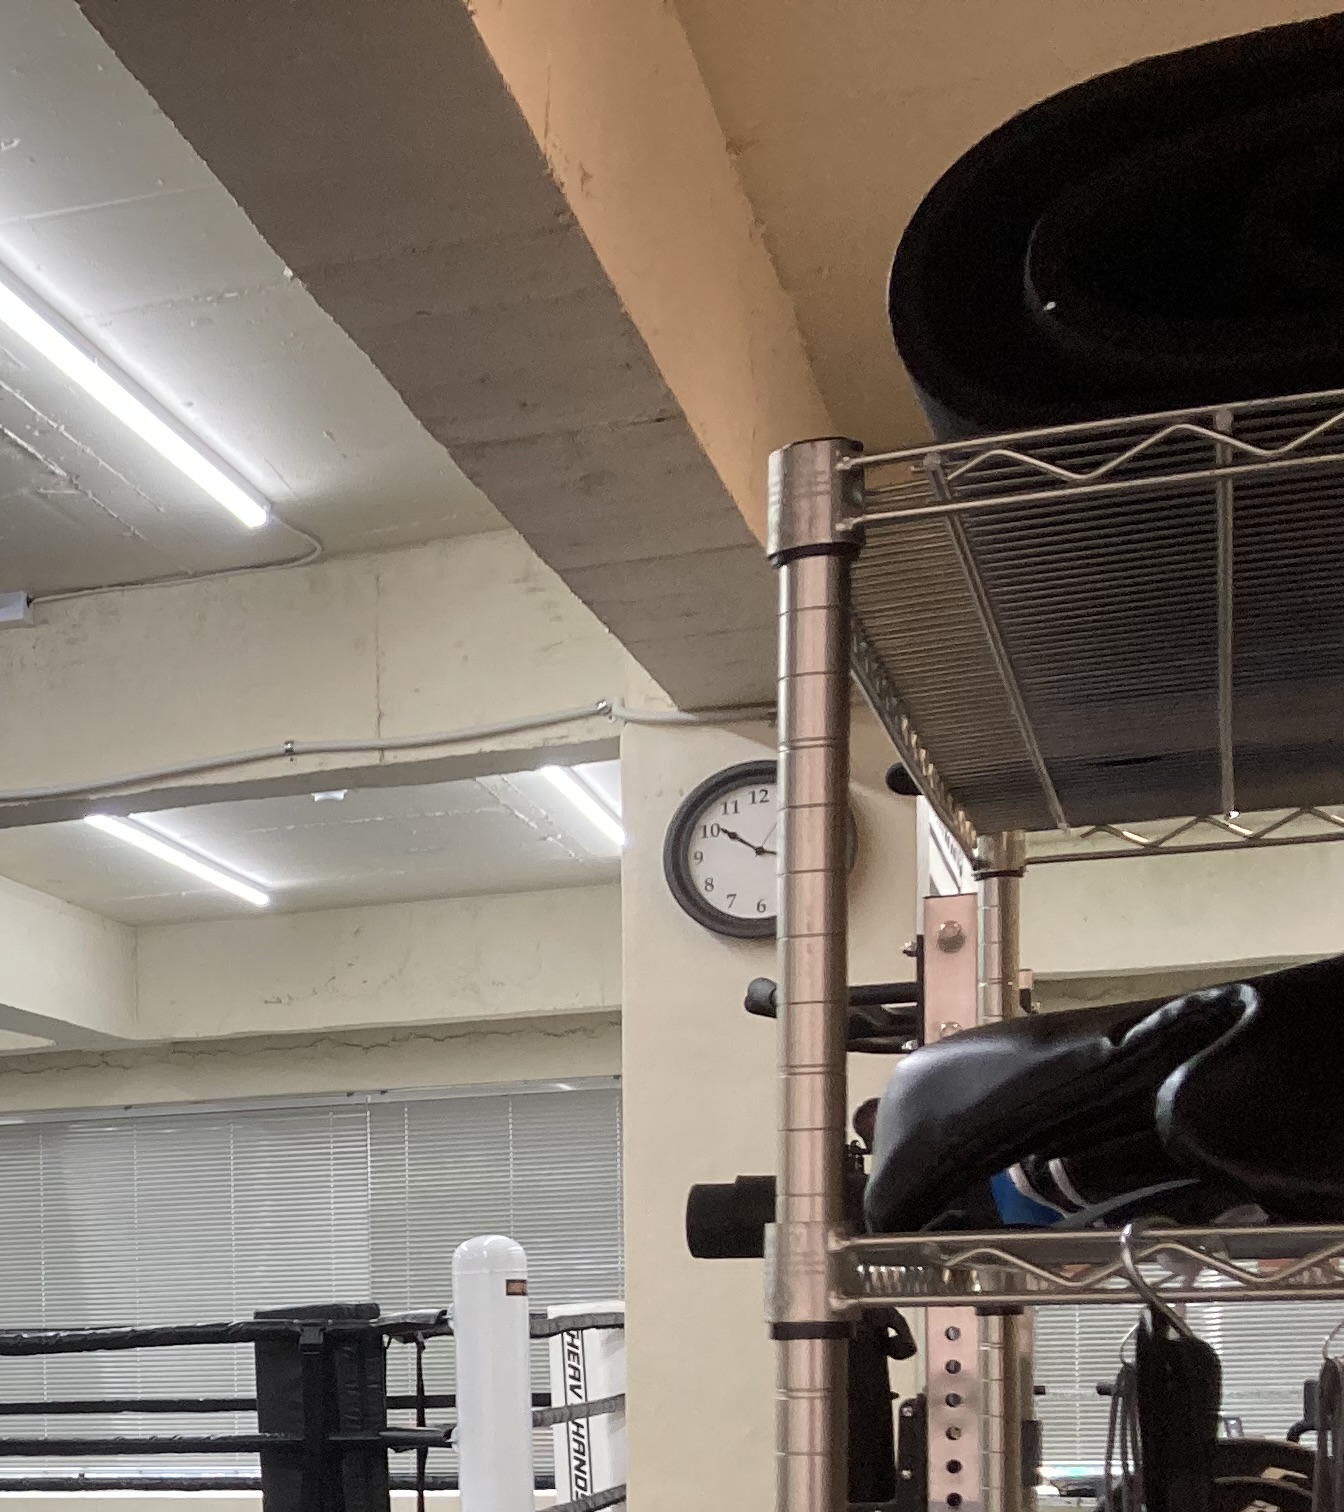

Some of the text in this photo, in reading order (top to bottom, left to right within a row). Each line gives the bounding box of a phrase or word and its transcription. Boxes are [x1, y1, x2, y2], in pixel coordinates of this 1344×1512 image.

[749, 788, 769, 805] 12
[721, 800, 740, 815] 11
[701, 822, 720, 839] 10
[694, 851, 703, 864] 9
[704, 877, 714, 892] 8
[726, 893, 736, 908] 7
[756, 899, 766, 913] 6
[566, 1330, 583, 1400] HEAV
